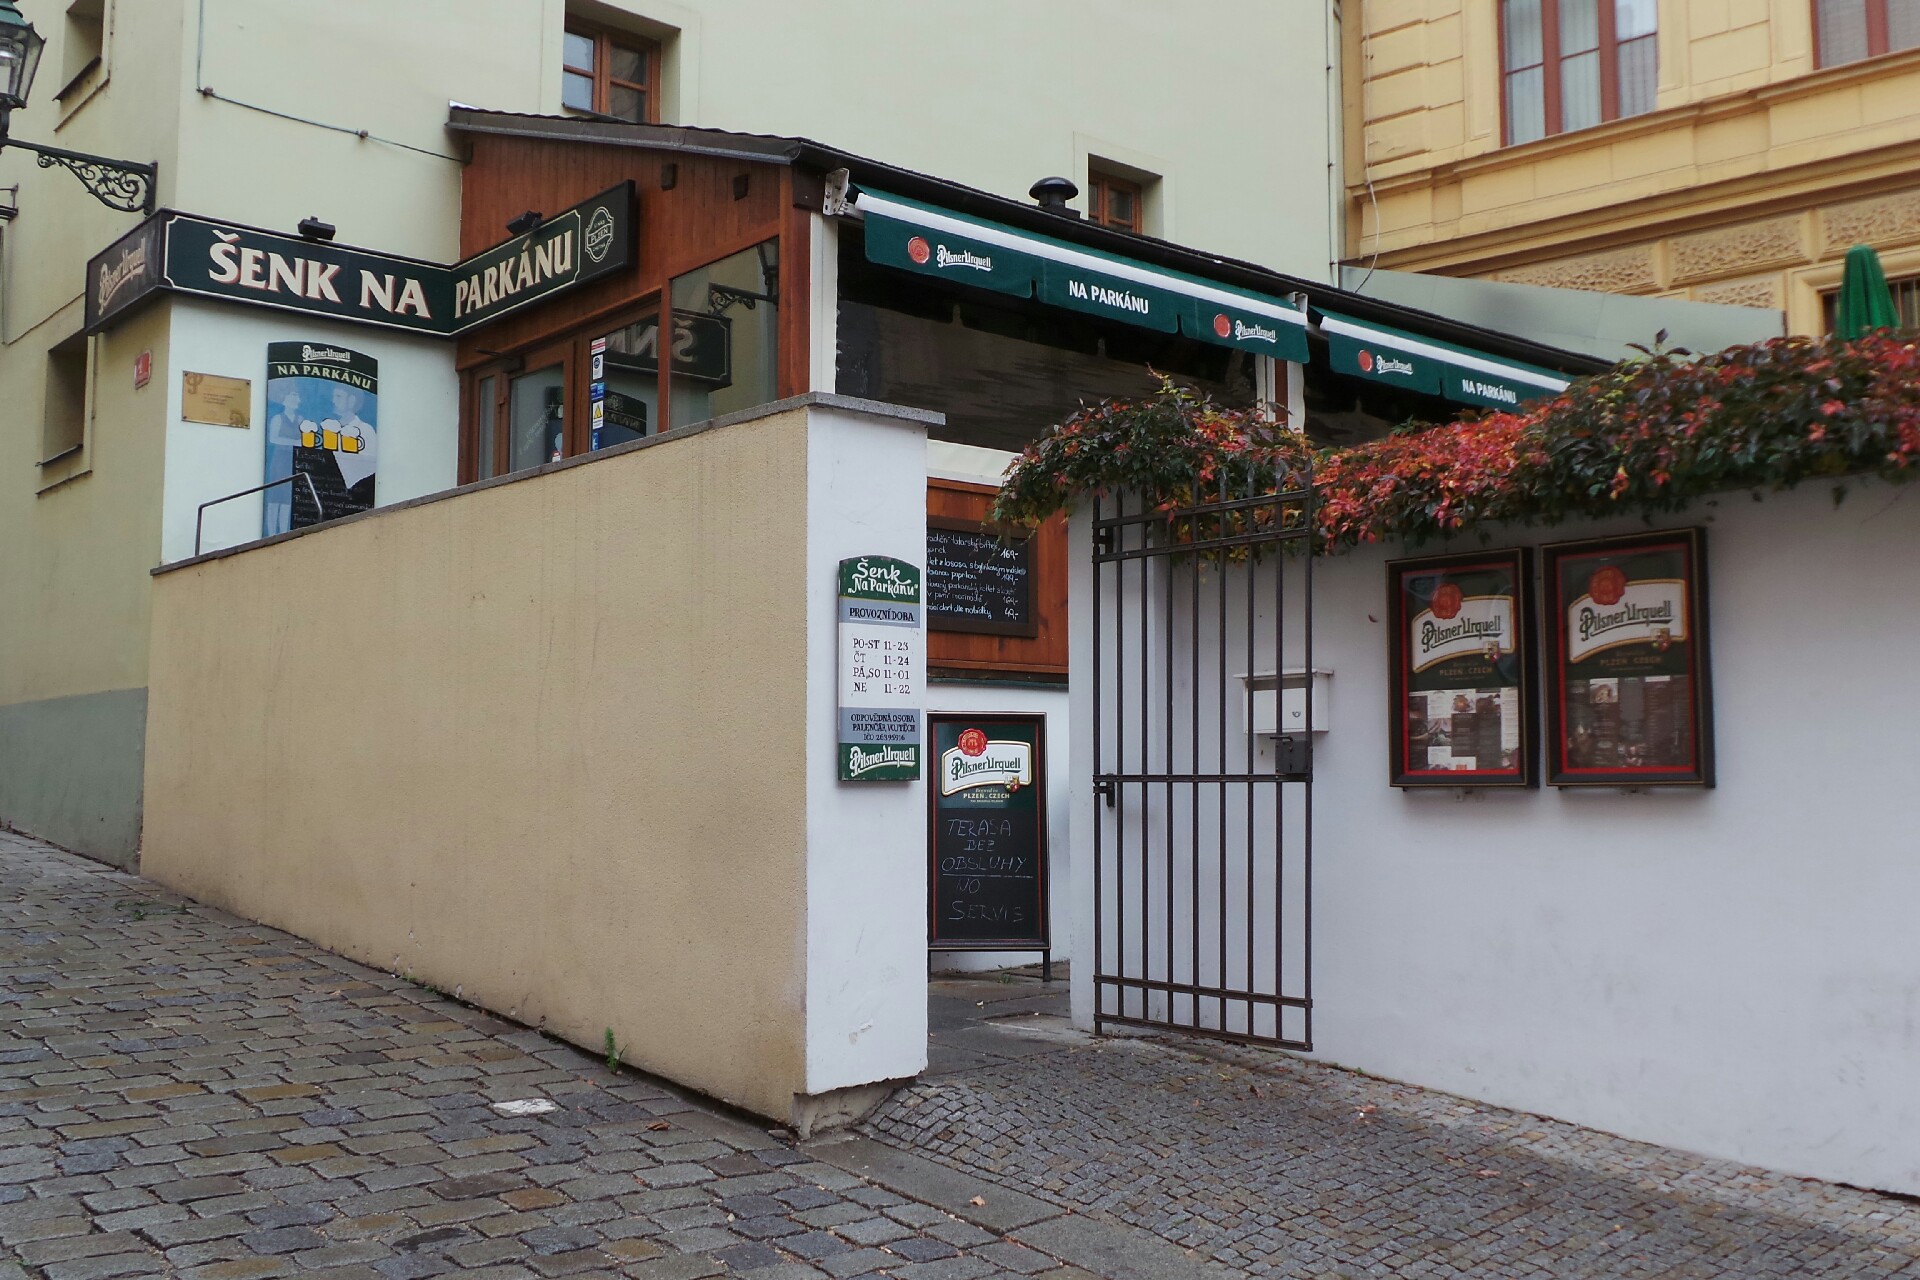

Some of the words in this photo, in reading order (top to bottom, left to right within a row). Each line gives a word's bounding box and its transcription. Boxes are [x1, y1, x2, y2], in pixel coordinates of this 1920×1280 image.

[936, 244, 965, 269] Pilsner
[964, 249, 993, 271] Urquell
[208, 229, 344, 304] ŠENK
[359, 269, 433, 320] NA
[454, 230, 574, 319] PARKÁNU
[1069, 279, 1088, 301] NA
[1091, 284, 1149, 315] PARKÁNU
[1234, 319, 1257, 341] Pilsner
[1255, 324, 1278, 343] Urquell
[302, 344, 328, 362] Pilsner
[327, 347, 351, 362] Urquell
[1376, 354, 1394, 374] Pilsner
[1392, 358, 1414, 375] Urquell
[277, 365, 299, 376] NA
[303, 365, 372, 390] PARKÁNU
[1462, 379, 1477, 395] NA
[1477, 382, 1517, 405] PARKÁNU
[852, 558, 912, 585] Šenk
[849, 607, 892, 620] PROVOZNÍ
[892, 610, 915, 622] DOBA
[1579, 606, 1627, 642] Pilsner
[1625, 600, 1673, 627] Urquell
[852, 638, 880, 650] PO-ST
[1421, 619, 1463, 654] Pilsner
[1461, 616, 1501, 640] Urquell
[853, 651, 866, 663] ČT
[853, 682, 868, 693] NE
[851, 713, 892, 723] ODPOVĚDNÁ
[892, 714, 915, 723] OSOBA
[849, 745, 884, 777] Pilsner
[883, 745, 915, 768] Urquell
[951, 756, 987, 781] Pilsner
[986, 756, 1021, 774] Urquell
[947, 818, 1011, 836] TERASA
[963, 839, 995, 852] BEZ
[941, 856, 1027, 873] OBSLUHY
[956, 878, 981, 894] NO
[948, 900, 1025, 922] SERVIS
